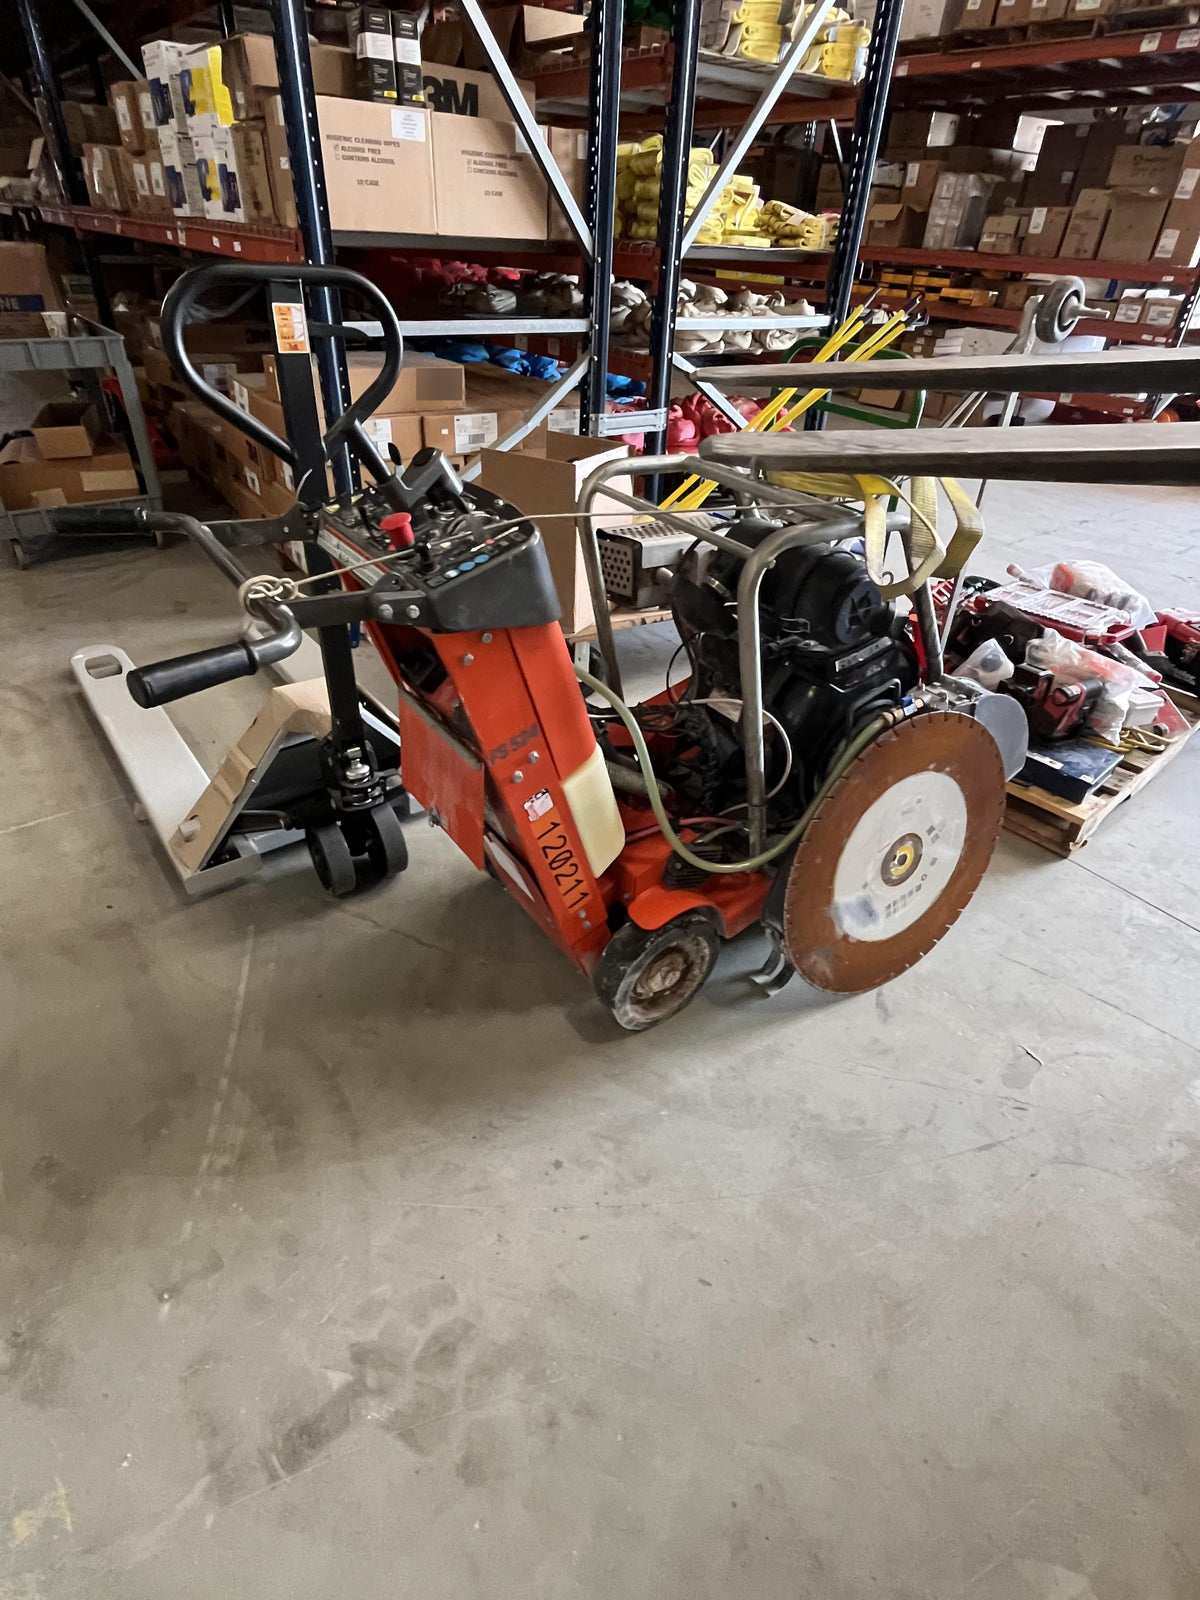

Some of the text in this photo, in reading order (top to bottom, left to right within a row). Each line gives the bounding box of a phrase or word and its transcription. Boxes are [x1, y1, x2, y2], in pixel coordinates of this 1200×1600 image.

[424, 76, 478, 117] 3M
[354, 137, 382, 146] CLEANING
[383, 140, 400, 148] WIPES
[341, 145, 365, 153] ALCOHOL
[341, 154, 395, 165] CONTAINS ALCOHOL
[473, 159, 494, 167] ALCOHOL
[537, 821, 591, 909] 120211
